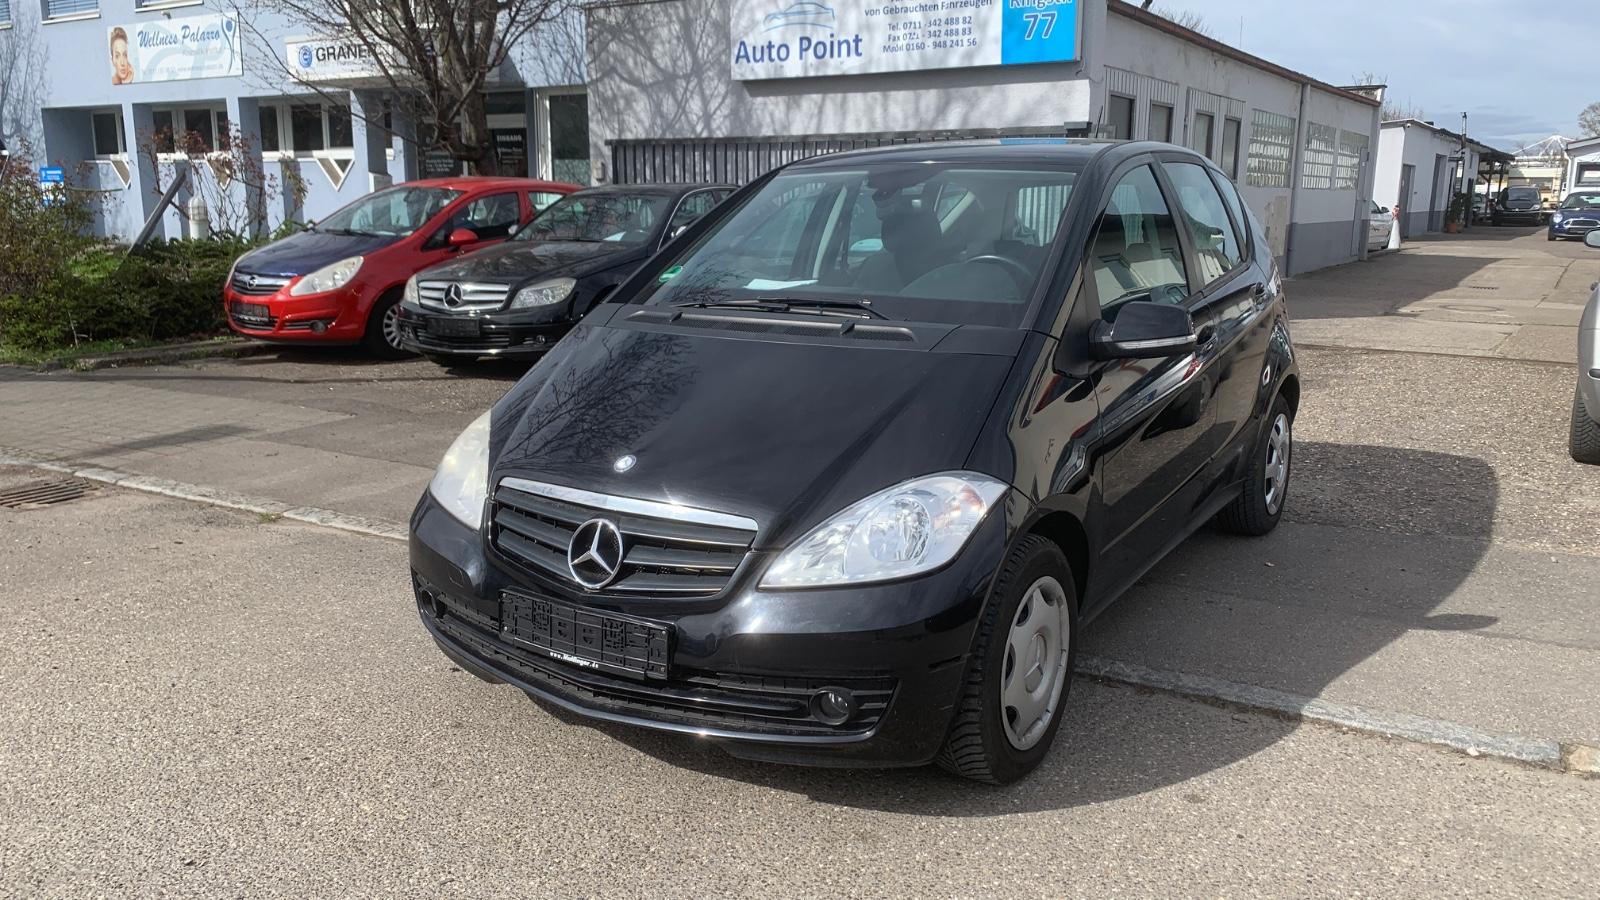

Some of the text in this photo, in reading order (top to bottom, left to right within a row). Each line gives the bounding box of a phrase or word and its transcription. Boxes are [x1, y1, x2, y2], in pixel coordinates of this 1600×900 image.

[864, 8, 880, 16] von
[883, 3, 939, 15] Gebrauchten
[888, 22, 901, 31] Tel.
[903, 21, 921, 30] 0711
[944, 16, 960, 25] 488
[961, 15, 972, 25] 82
[1023, 11, 1057, 40] 77
[137, 24, 220, 48] Wellness Palazzo
[888, 34, 900, 42] Fax
[927, 29, 942, 38] 342
[944, 28, 960, 37] 488
[961, 27, 972, 36] 83
[735, 33, 863, 64] Auto Point
[906, 42, 926, 51] 0160
[932, 40, 948, 50] 948
[949, 39, 964, 48] 241
[967, 37, 977, 47] 56
